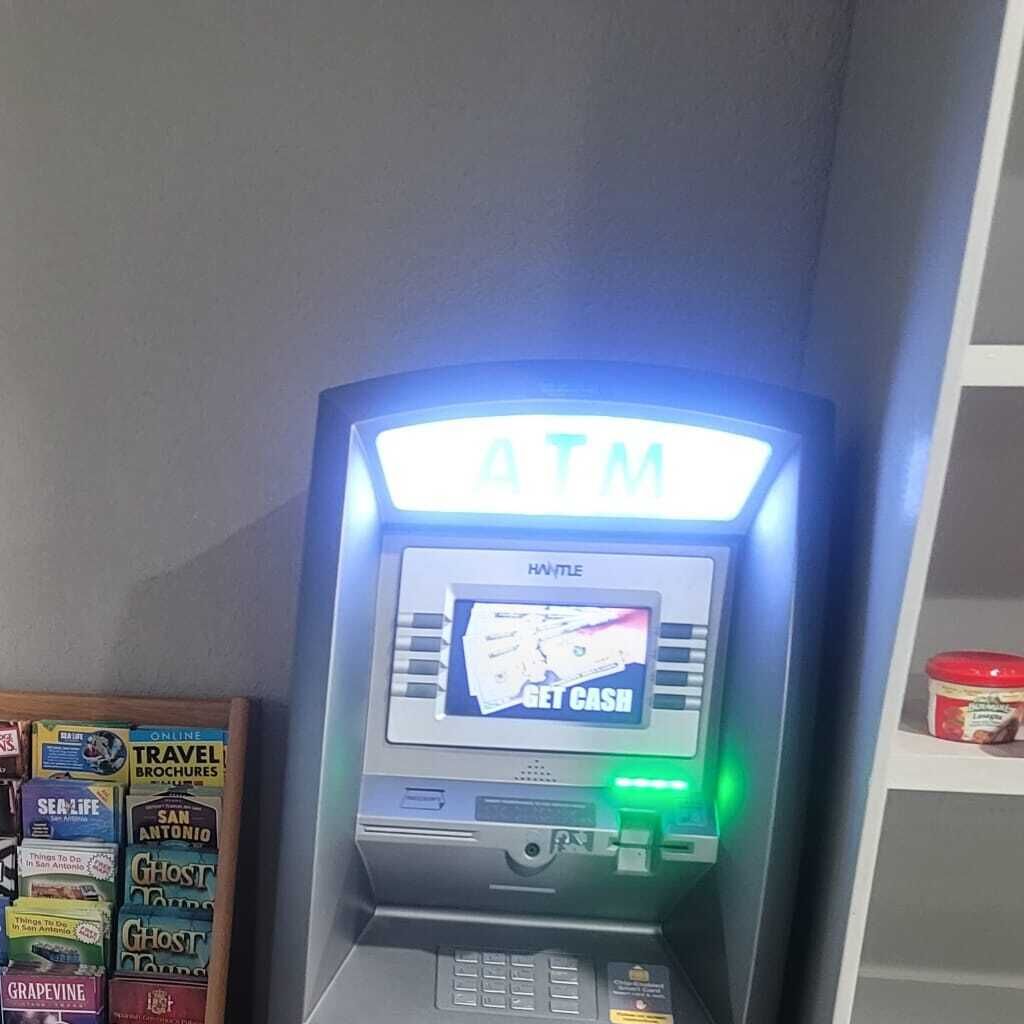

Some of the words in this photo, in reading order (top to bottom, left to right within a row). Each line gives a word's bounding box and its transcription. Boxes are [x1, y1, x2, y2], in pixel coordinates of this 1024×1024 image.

[479, 432, 663, 496] ATM
[528, 563, 583, 578] HANTLE
[523, 686, 563, 710] GET
[570, 688, 632, 713] CASH
[150, 731, 202, 740] ONLINE
[134, 746, 220, 764] TRAVEL
[136, 766, 218, 778] BROCHURES
[157, 810, 190, 825] SAN
[138, 824, 210, 842] ANTONIO
[29, 852, 56, 862] Things
[58, 854, 69, 862] To
[131, 852, 215, 889] GHOST
[8, 982, 86, 1001] GRAPEVINE
